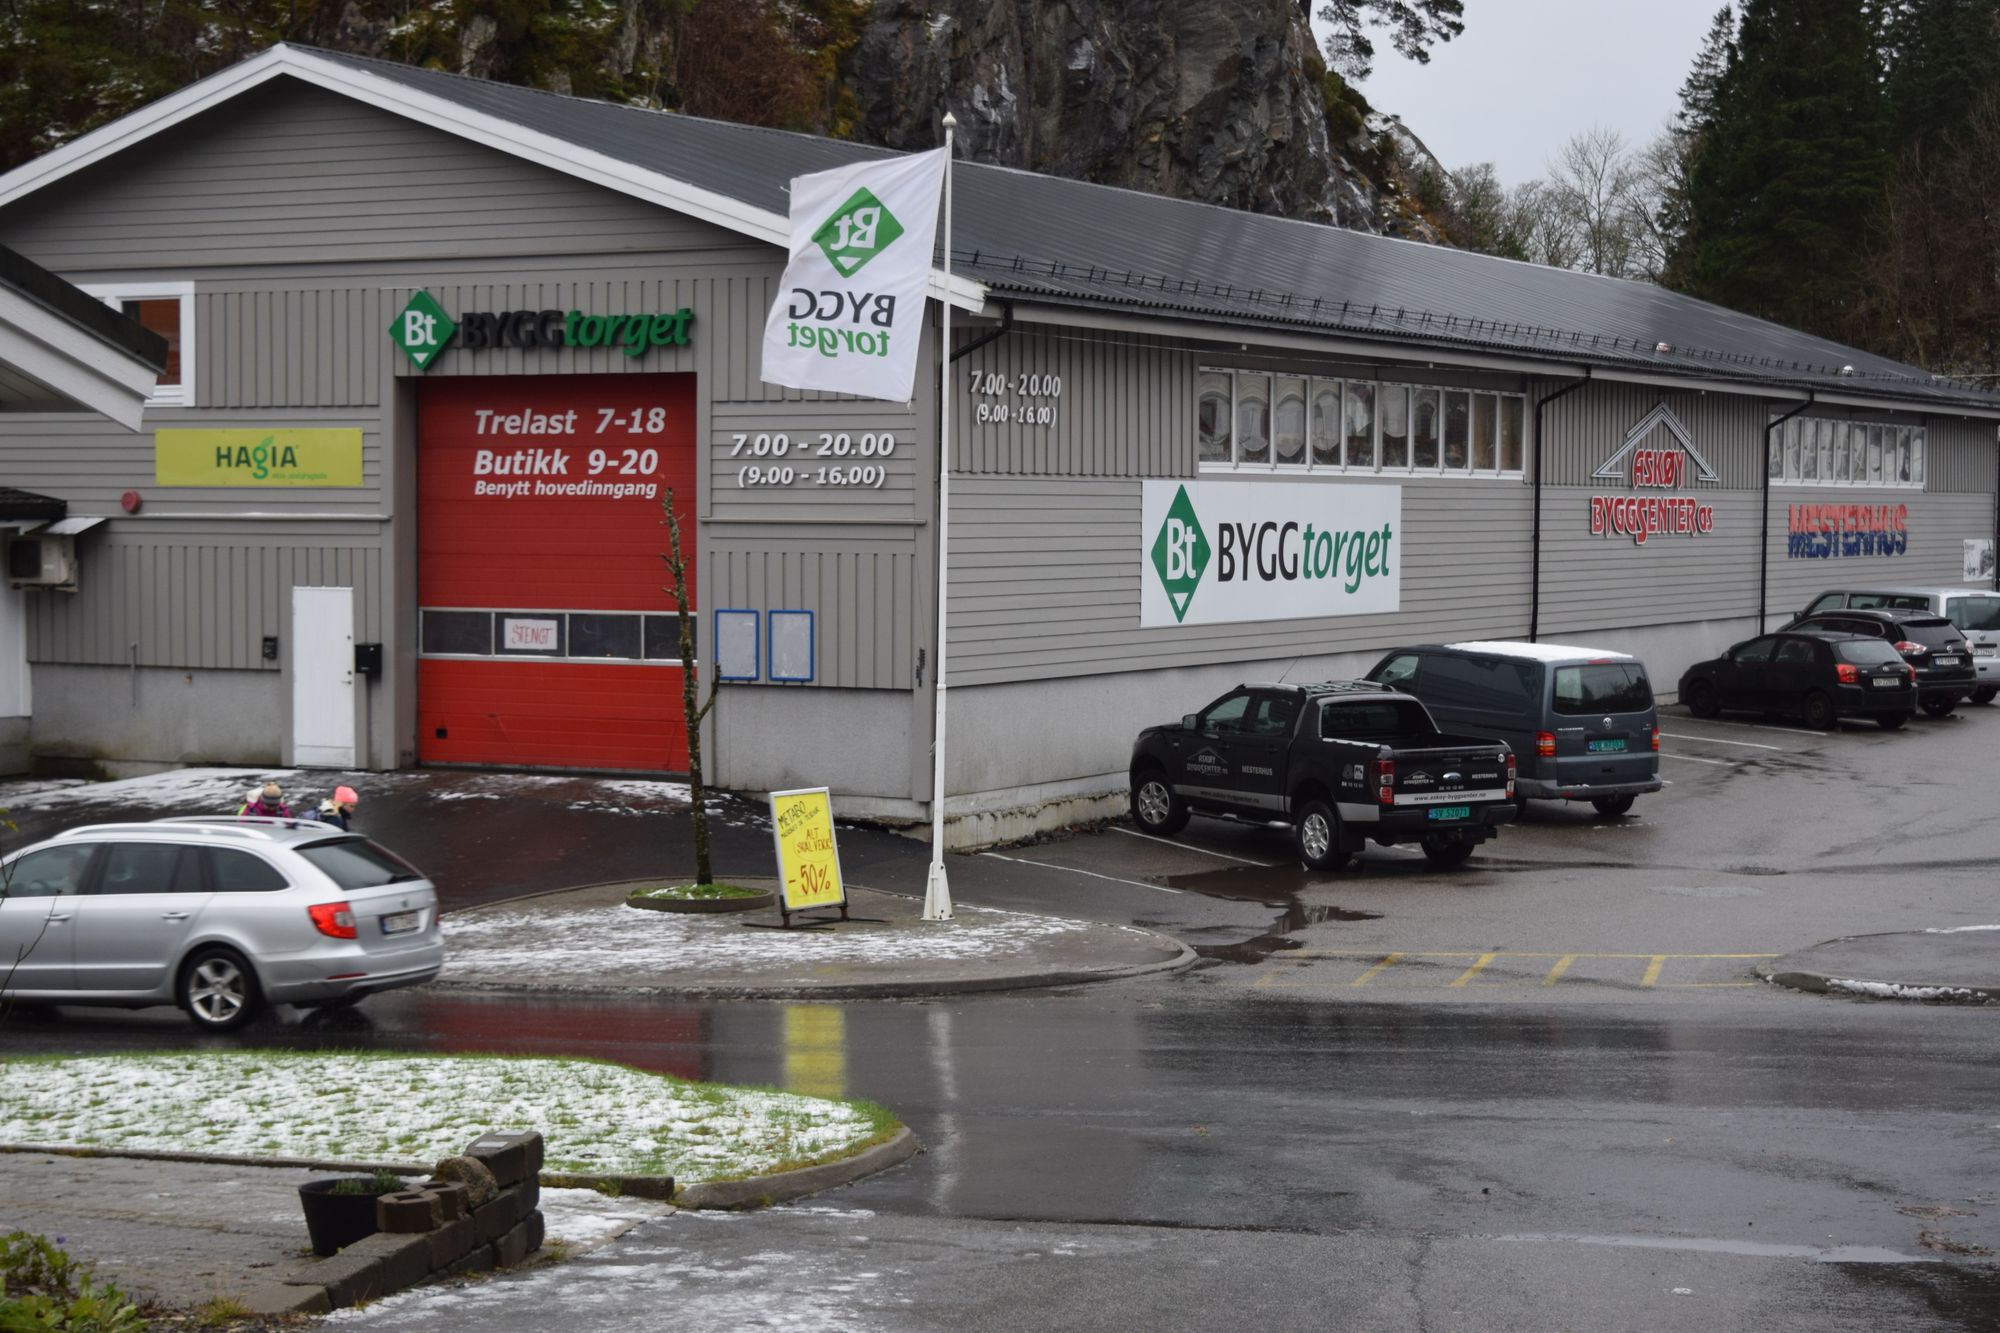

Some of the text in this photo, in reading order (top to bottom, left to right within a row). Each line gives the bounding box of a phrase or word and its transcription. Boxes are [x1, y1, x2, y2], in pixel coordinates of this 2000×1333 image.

[404, 310, 437, 346] Bt
[970, 370, 1005, 396] 7.00
[1018, 373, 1062, 398] 20.00
[474, 407, 667, 435] Trelast 7-18
[976, 403, 1009, 425] (9.00
[1018, 406, 1057, 429] 16.00)
[730, 433, 790, 457] 7.00
[816, 433, 896, 457] 20.00
[473, 449, 659, 476] Butikk 9-20
[1632, 448, 1686, 490] ASKØY
[474, 479, 658, 500] Benytt hovedinngang
[738, 465, 795, 489] (9.00
[815, 465, 886, 489] 16.00)
[1590, 495, 1698, 545] BYGGSENTER
[1787, 503, 1908, 559] MESTERHUS
[1166, 517, 1197, 581] Bt
